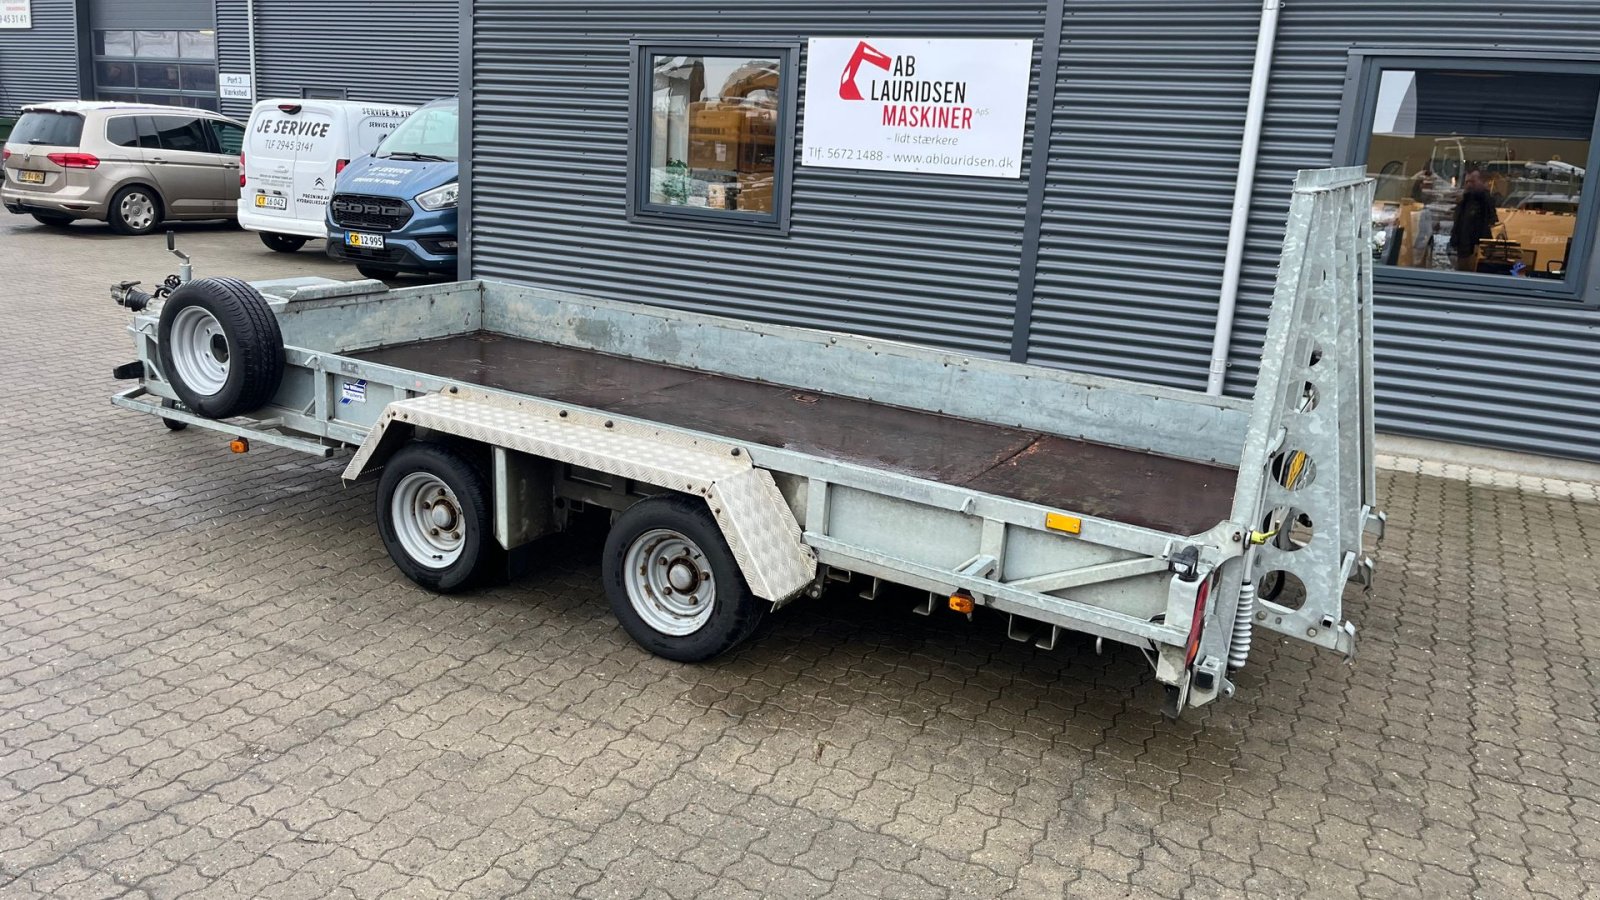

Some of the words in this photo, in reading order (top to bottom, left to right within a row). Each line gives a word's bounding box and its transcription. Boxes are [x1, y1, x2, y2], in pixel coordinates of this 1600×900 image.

[4, 15, 10, 23] 45
[11, 15, 18, 23] 31
[20, 15, 26, 23] 41
[893, 55, 916, 77] AB
[227, 76, 238, 84] Port
[871, 80, 966, 103] LAURIDSEN
[362, 108, 389, 117] SERVICE
[882, 105, 973, 129] MASKINER
[975, 108, 989, 117] ApS
[257, 119, 273, 134] JE
[273, 120, 330, 138] SERVICE
[265, 139, 276, 149] TLF
[276, 140, 295, 151] 2945
[296, 141, 314, 152] 3141
[894, 133, 910, 144] lidt
[912, 135, 959, 146] stærkere
[809, 147, 824, 159] Tlf.
[827, 148, 853, 160] 5672
[856, 149, 883, 161] 1488
[893, 152, 1014, 169] www.ablauridsen.dk
[257, 197, 266, 205] CT
[266, 198, 273, 206] 16
[274, 198, 284, 207] 042
[333, 201, 400, 216] FORD
[349, 234, 359, 245] CP
[360, 236, 369, 245] 12
[369, 235, 383, 246] 995
